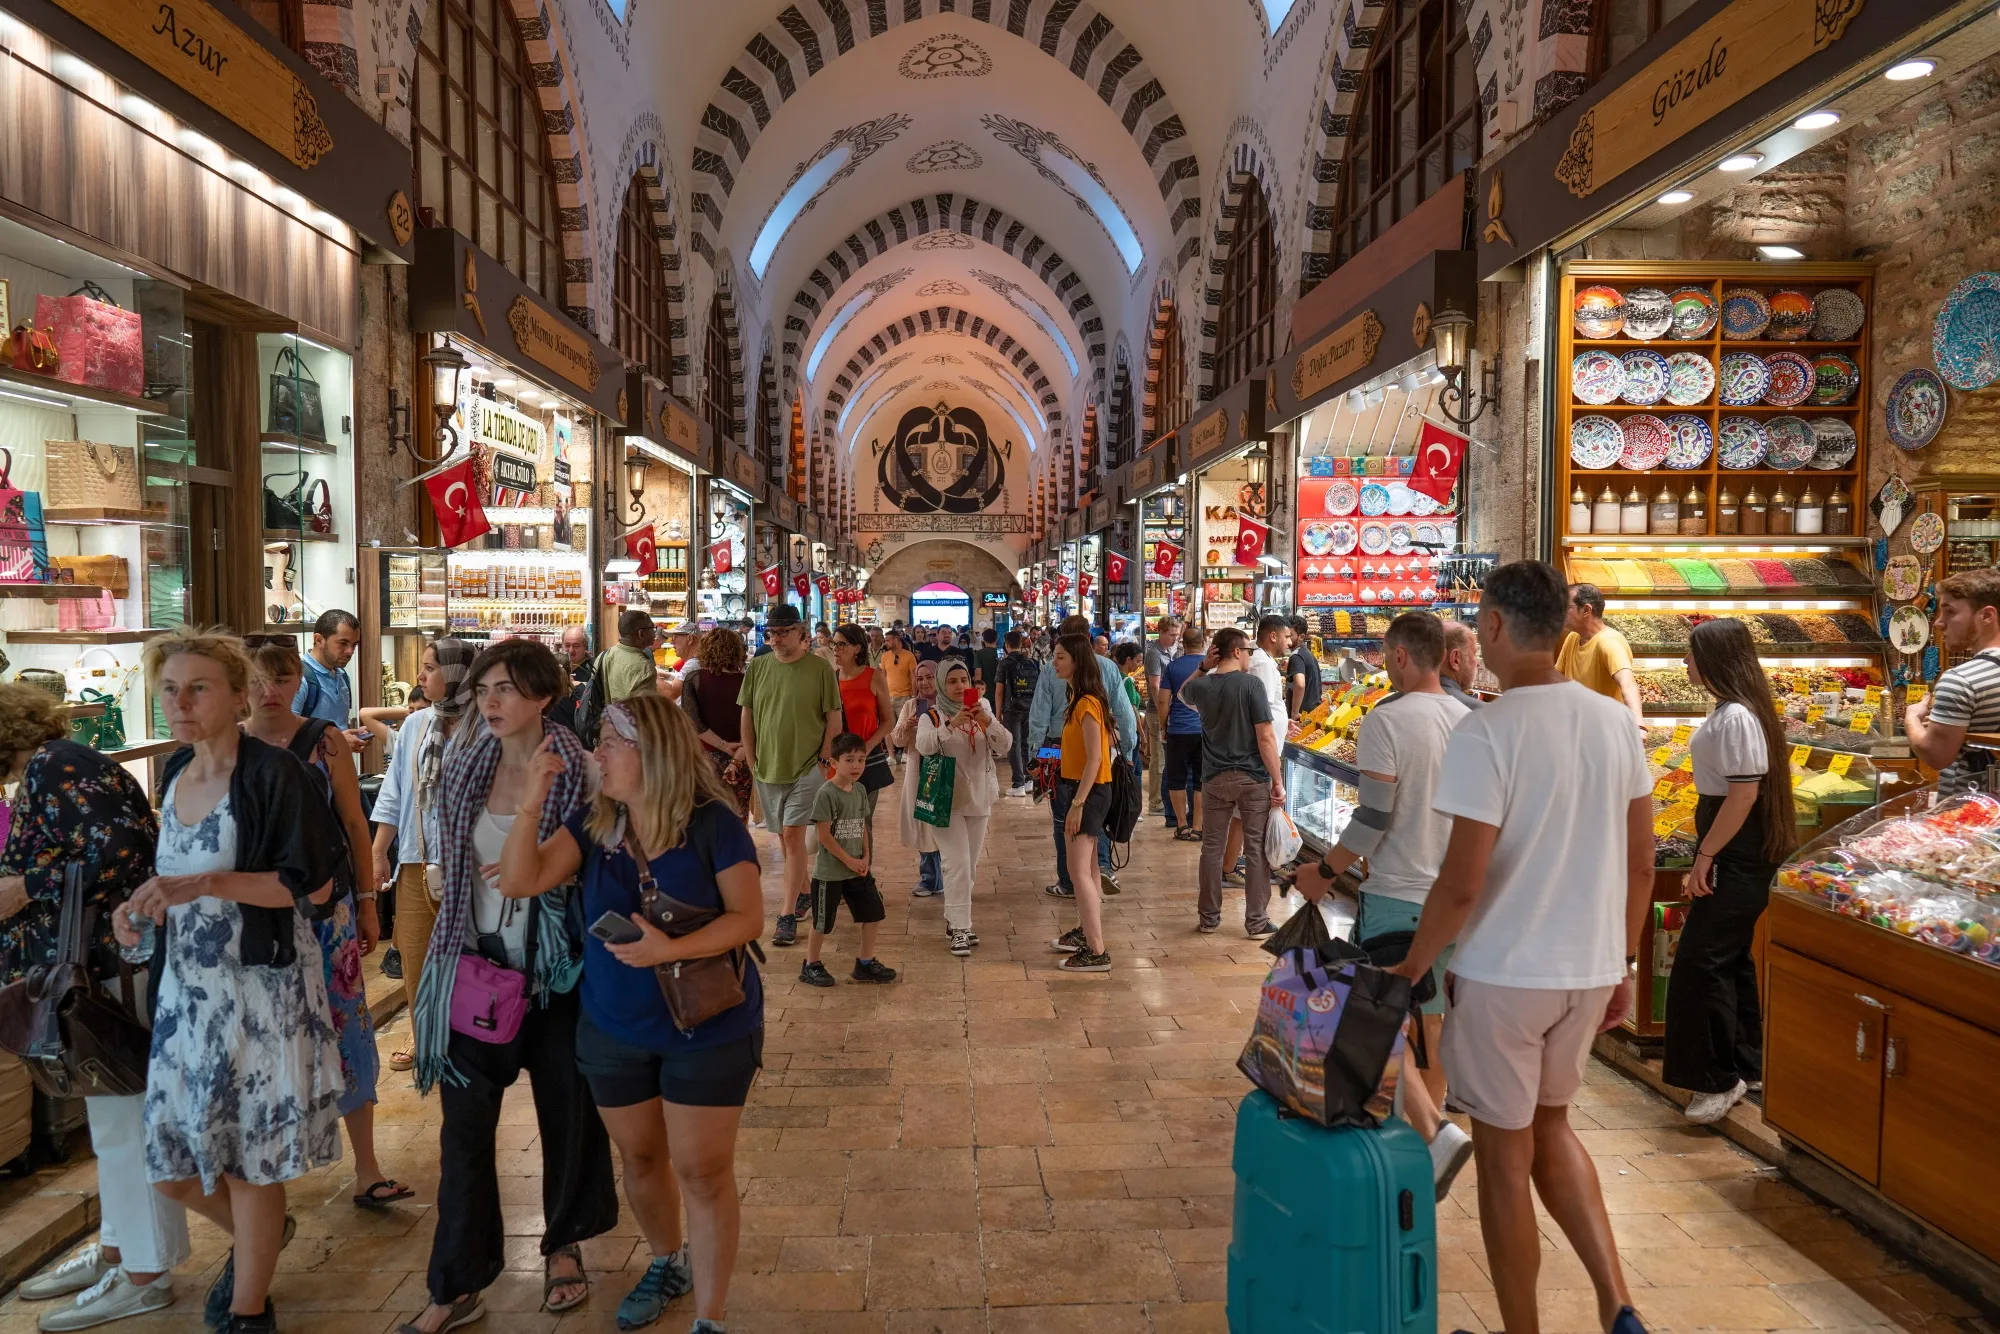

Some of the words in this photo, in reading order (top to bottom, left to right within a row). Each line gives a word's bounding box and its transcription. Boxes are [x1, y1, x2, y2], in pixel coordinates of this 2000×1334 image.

[152, 4, 228, 77] Azur
[1652, 36, 1727, 127] Gözde
[396, 203, 410, 232] 22
[1415, 316, 1424, 335] 21
[483, 408, 492, 438] LA
[501, 461, 517, 480] AKTAR
